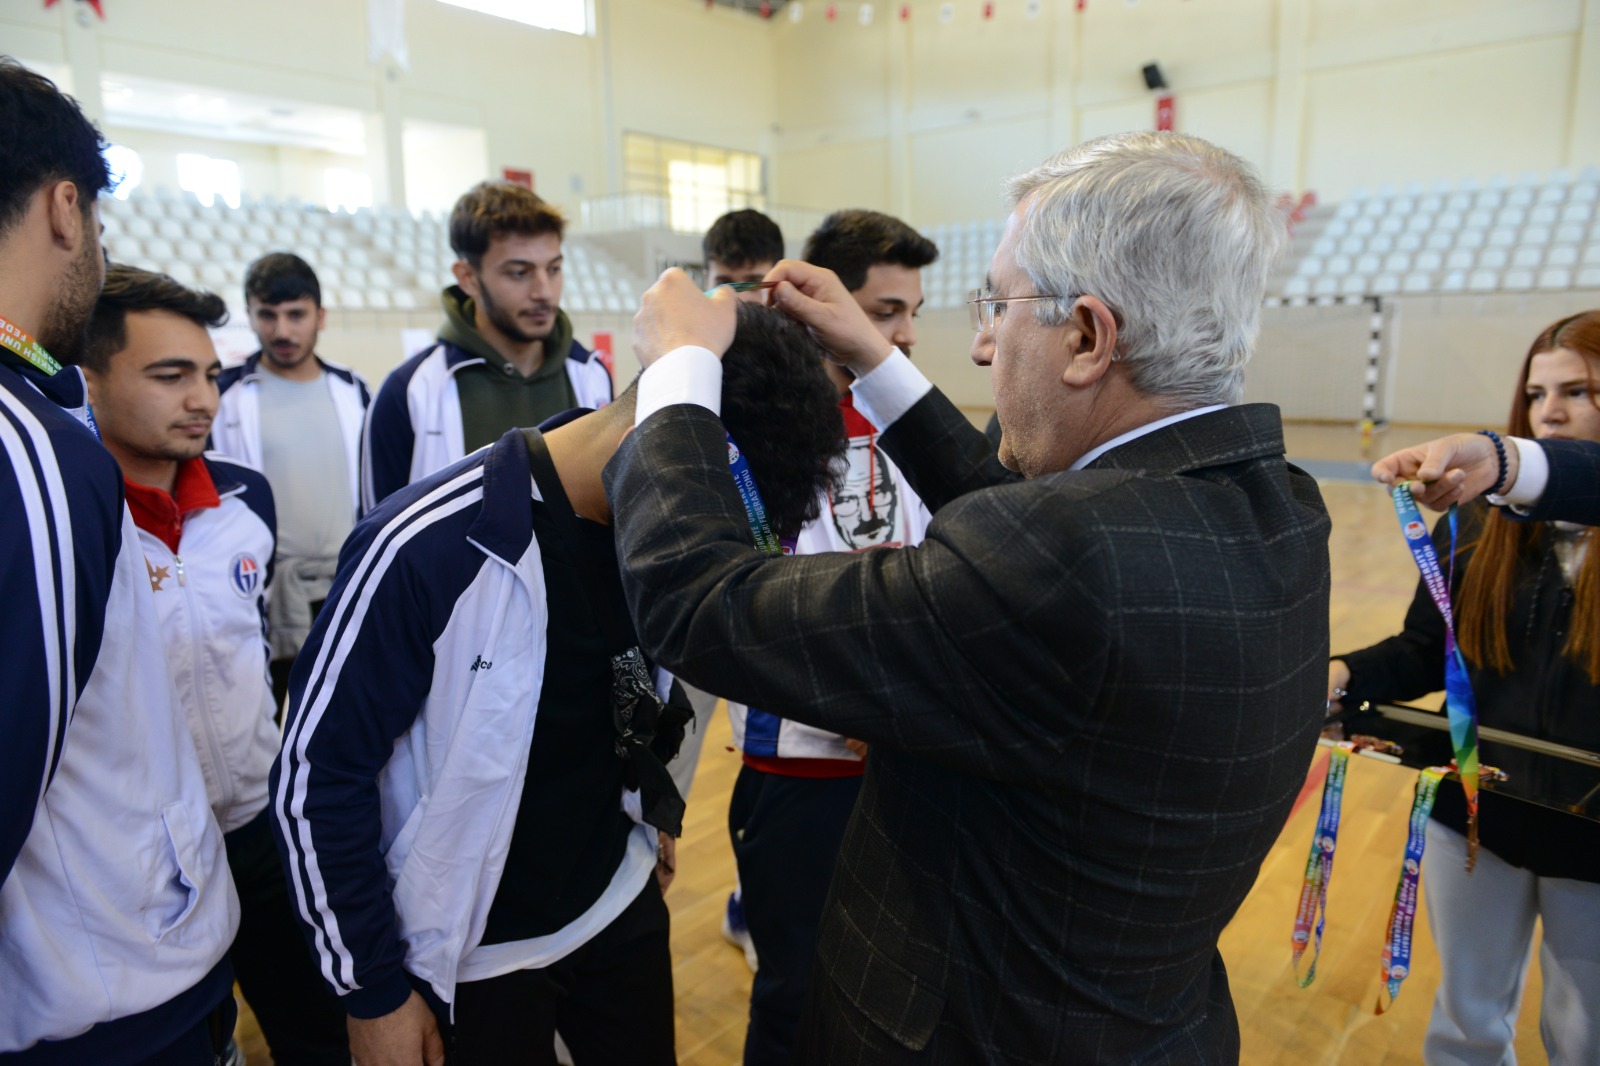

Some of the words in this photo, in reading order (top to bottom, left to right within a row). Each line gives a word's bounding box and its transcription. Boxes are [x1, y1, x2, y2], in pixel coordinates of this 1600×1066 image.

[741, 469, 766, 523] FEDERASYONU
[1413, 547, 1440, 600] UNIVERSITY
[1423, 544, 1446, 598] FEDERATION
